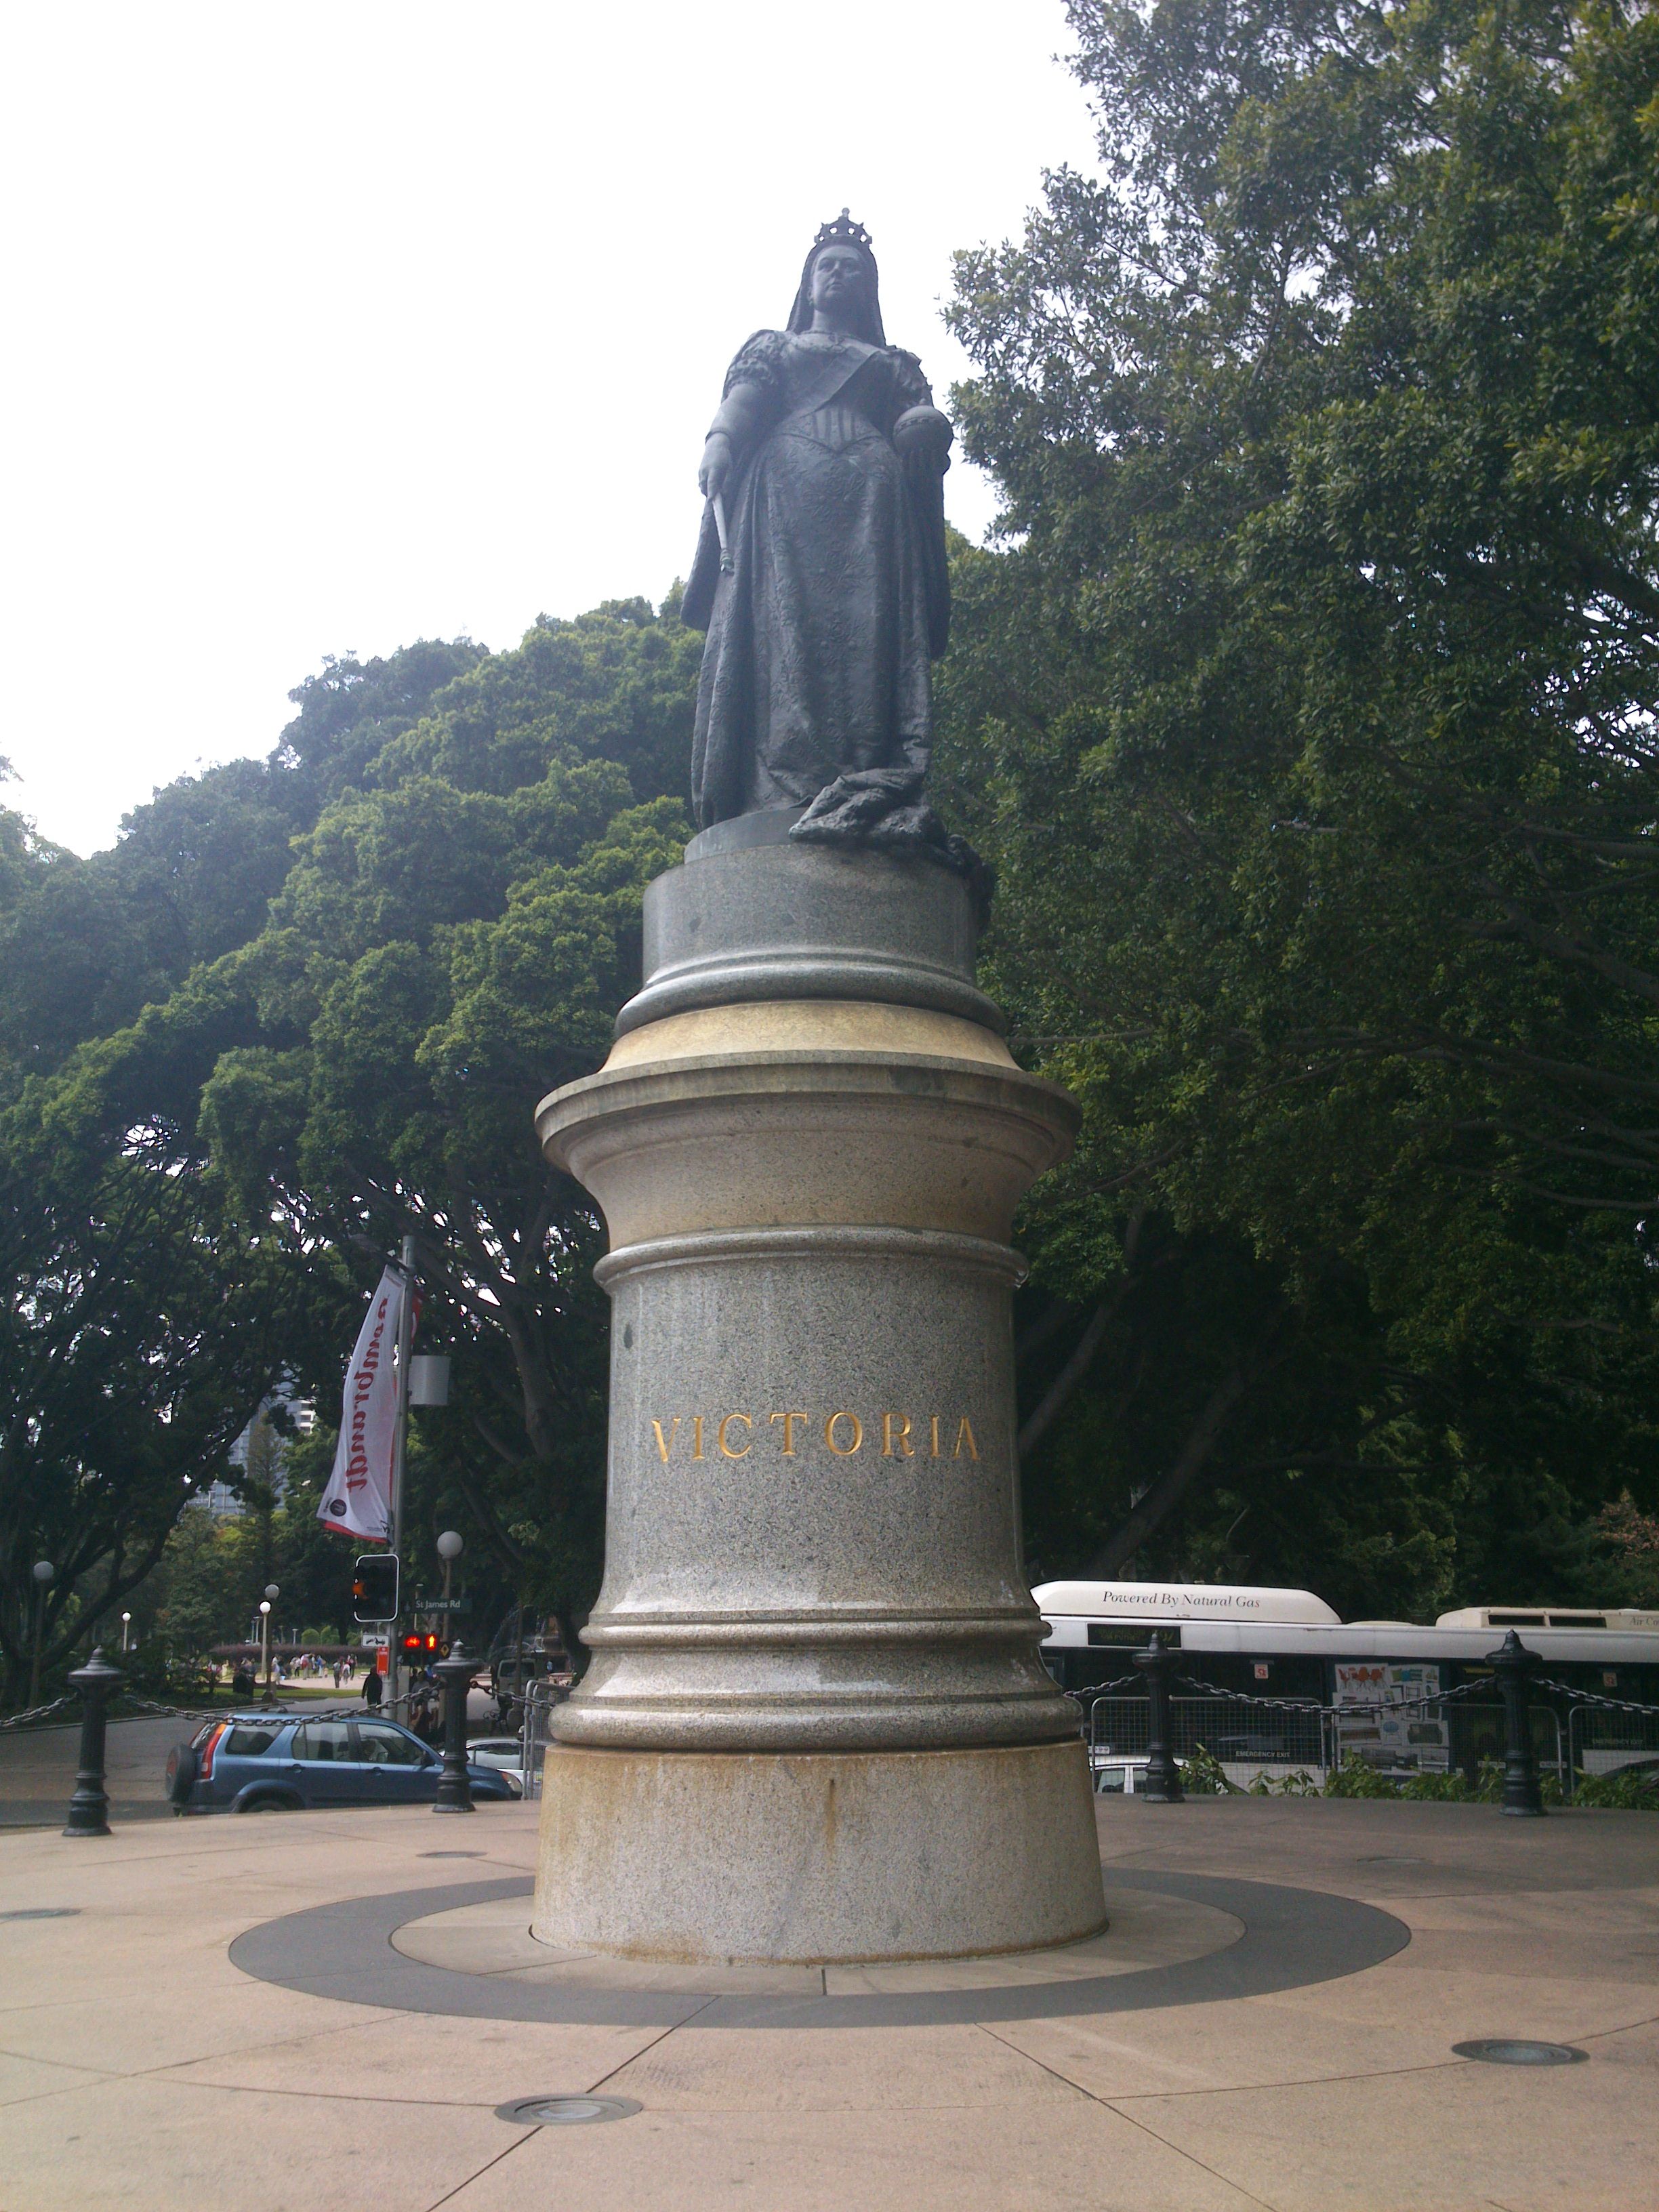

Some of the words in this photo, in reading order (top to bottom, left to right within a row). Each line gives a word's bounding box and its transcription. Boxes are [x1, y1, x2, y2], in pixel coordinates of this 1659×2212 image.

[651, 1411, 981, 1463] VICTORIA
[415, 1600, 424, 1608] St
[424, 1600, 448, 1610] James
[450, 1600, 461, 1608] Rd
[1103, 1591, 1158, 1604] Powered
[1161, 1593, 1179, 1607] By
[1181, 1594, 1231, 1606] Natural
[1236, 1595, 1260, 1607] Gas
